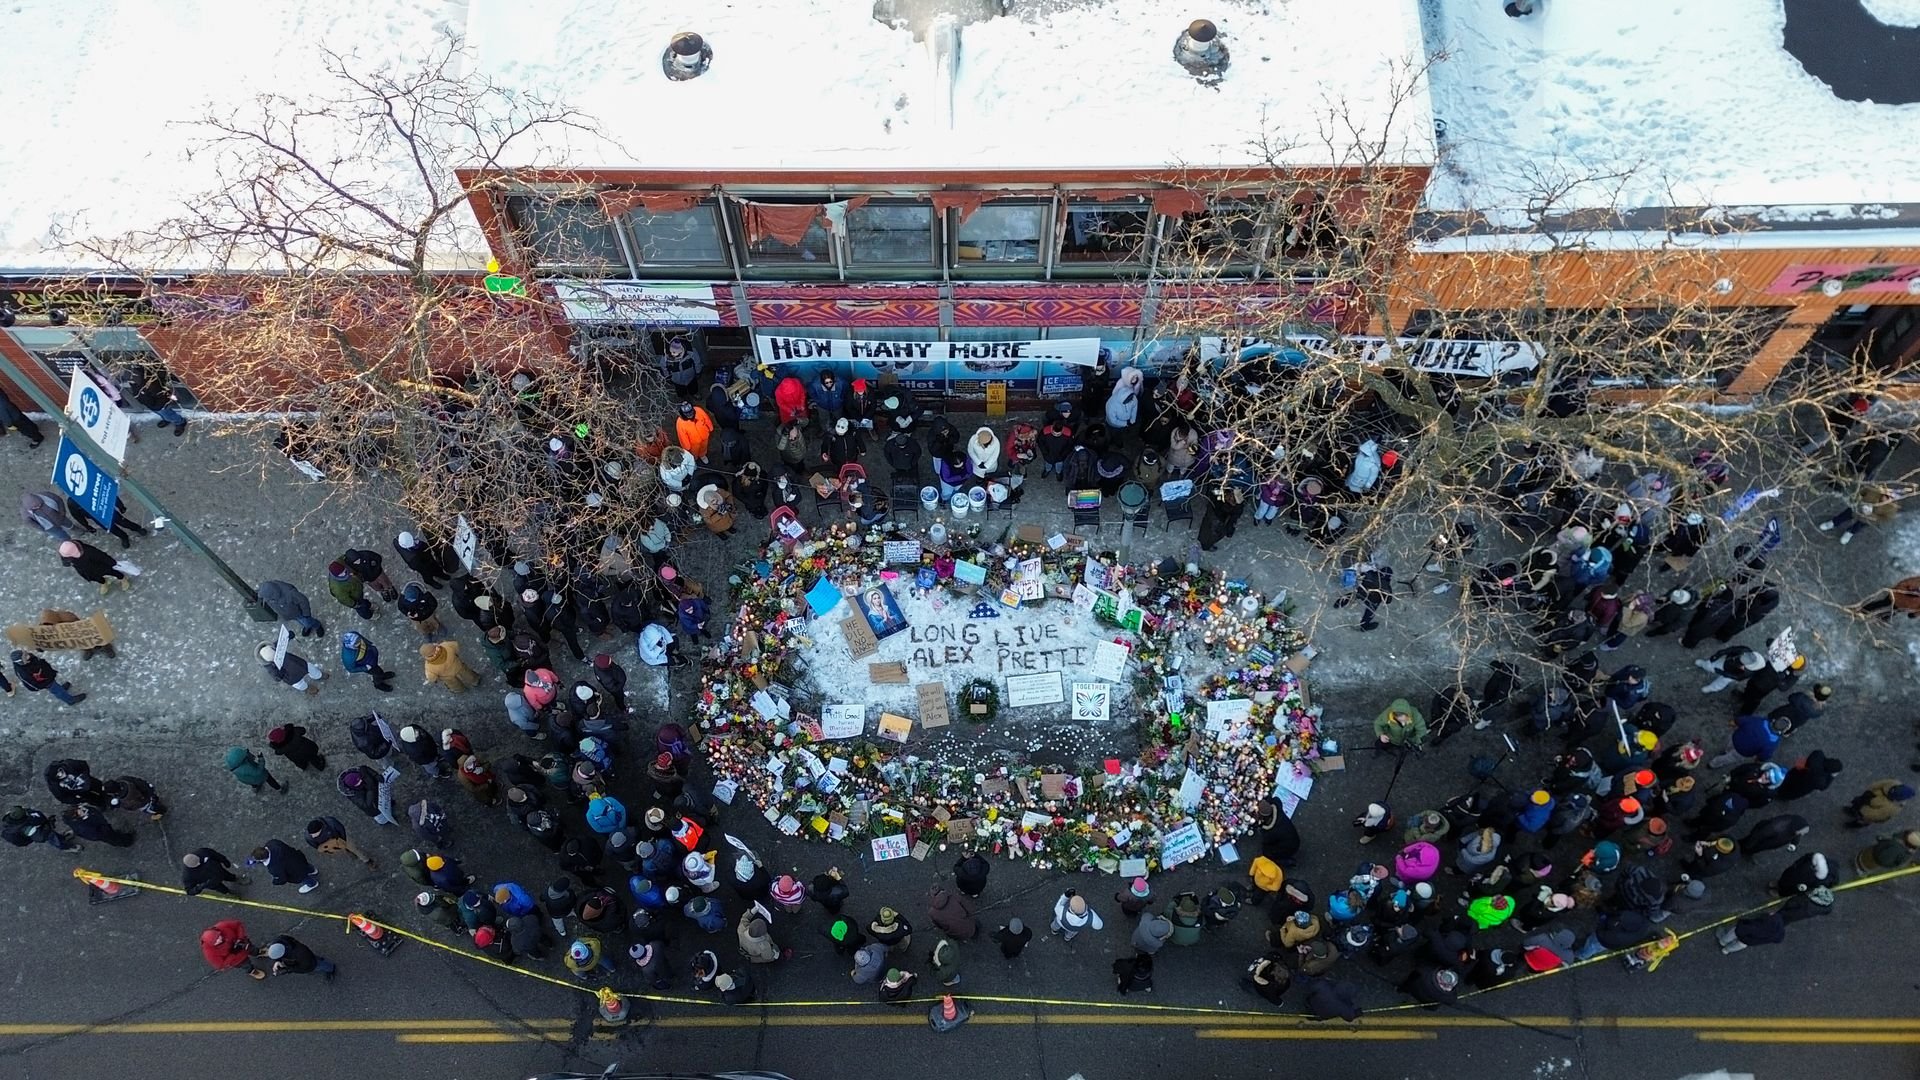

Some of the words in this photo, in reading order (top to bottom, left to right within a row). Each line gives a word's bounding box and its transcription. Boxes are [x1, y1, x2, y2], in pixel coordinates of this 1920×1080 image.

[620, 294, 679, 302] AMERICAN
[770, 337, 832, 360] HOW
[851, 341, 931, 358] MANY
[1044, 376, 1059, 384] ICE
[92, 472, 103, 498] street
[846, 620, 858, 631] HE
[846, 629, 865, 641] DID
[910, 624, 980, 645] LONG
[994, 624, 1058, 648] LIVE
[854, 637, 868, 647] NO
[910, 647, 975, 666] ALEX
[996, 647, 1087, 672] PRETTI
[798, 714, 812, 724] Alex
[926, 713, 944, 722] Alex
